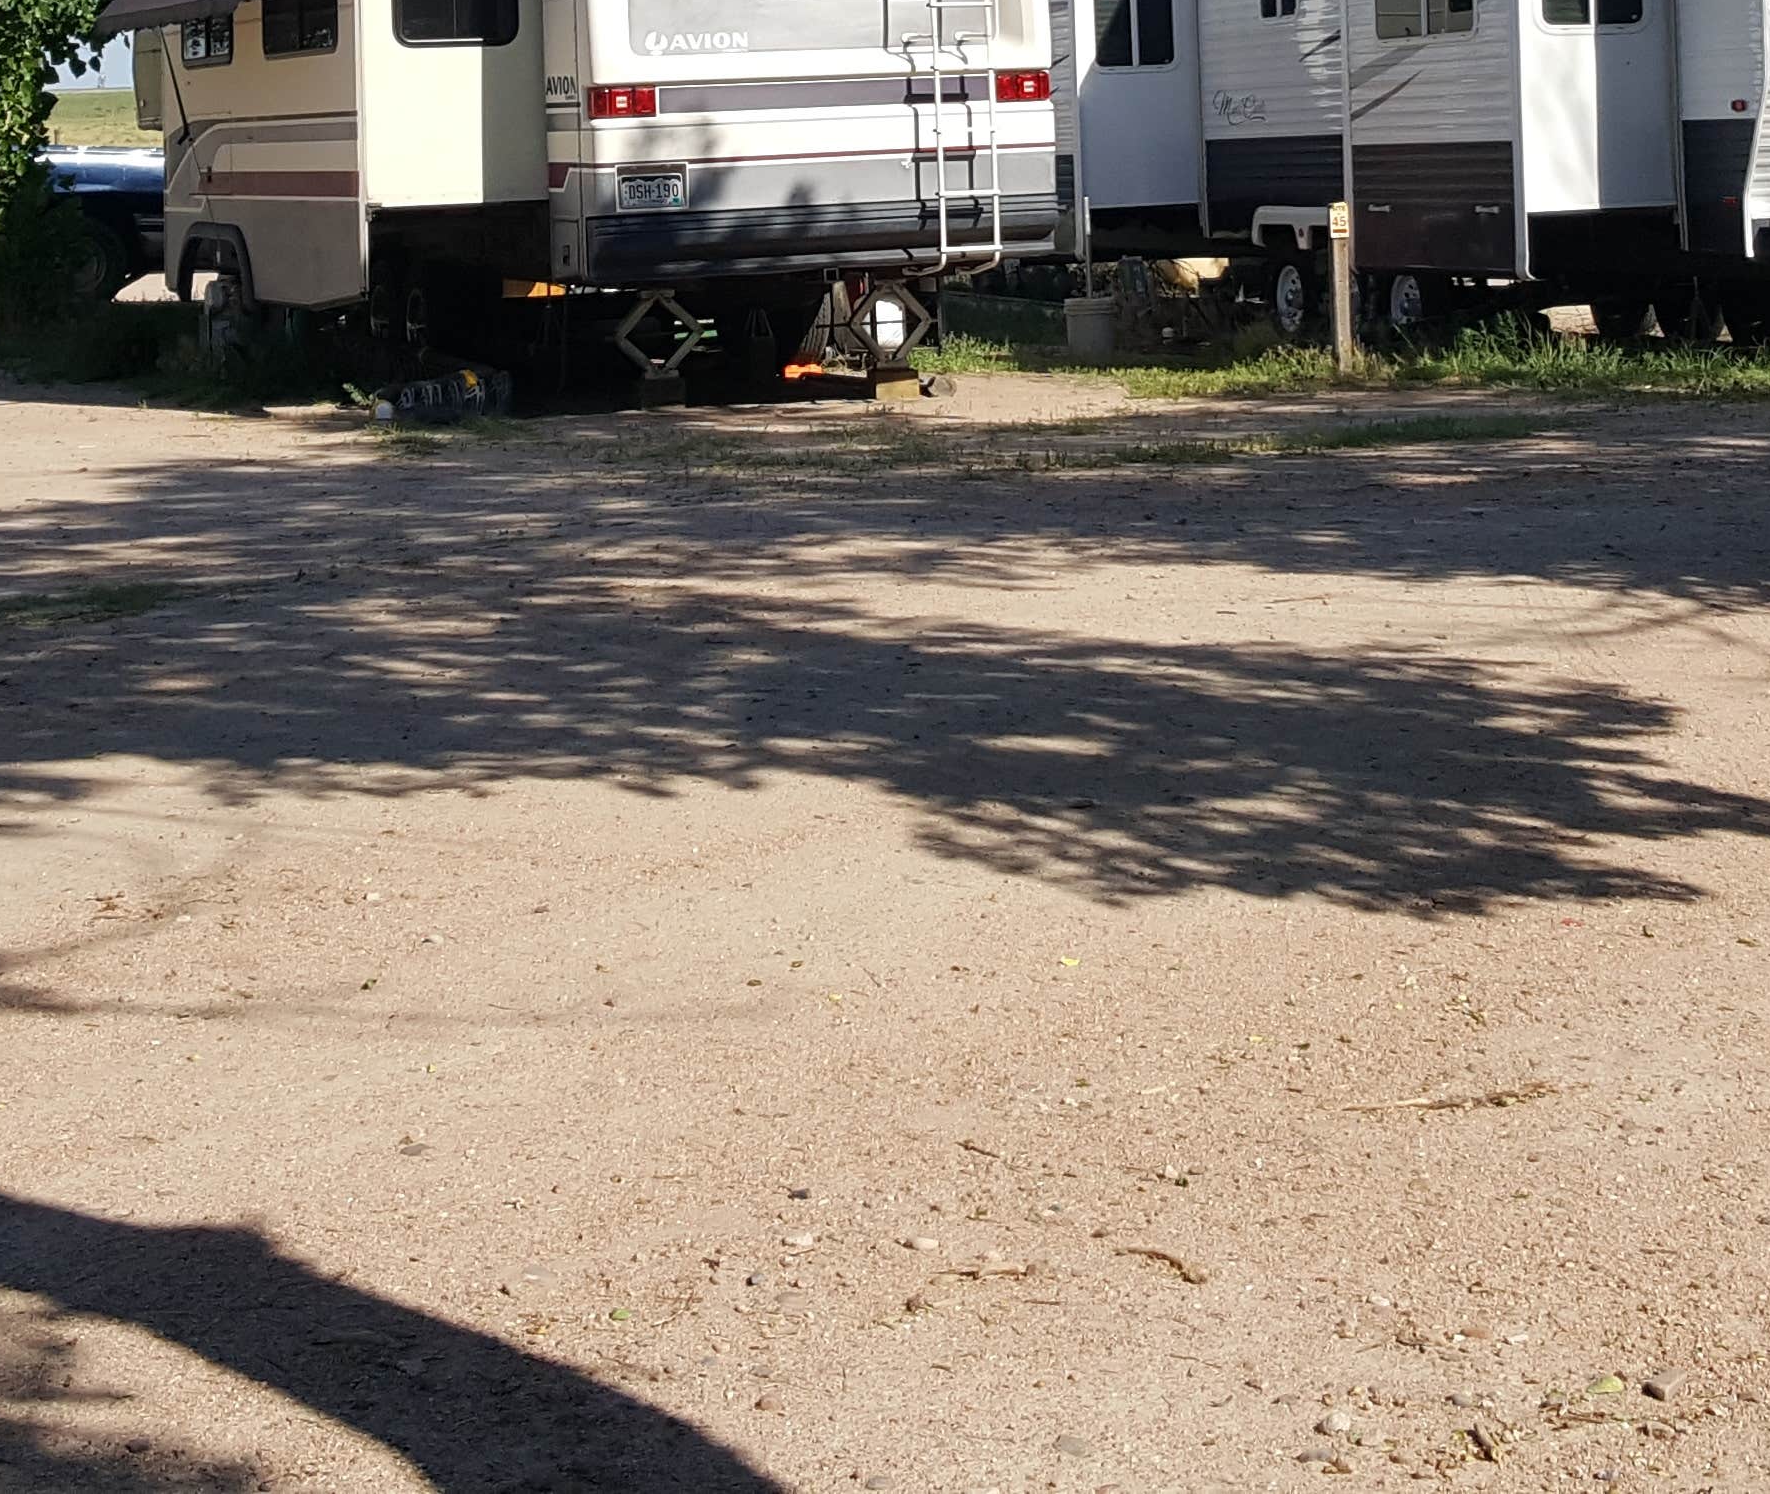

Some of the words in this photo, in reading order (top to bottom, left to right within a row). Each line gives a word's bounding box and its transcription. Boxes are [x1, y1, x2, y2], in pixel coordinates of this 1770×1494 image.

[669, 31, 749, 51] AVION
[545, 75, 577, 96] AVION
[628, 182, 679, 200] DSH-190
[1332, 216, 1347, 227] 45
